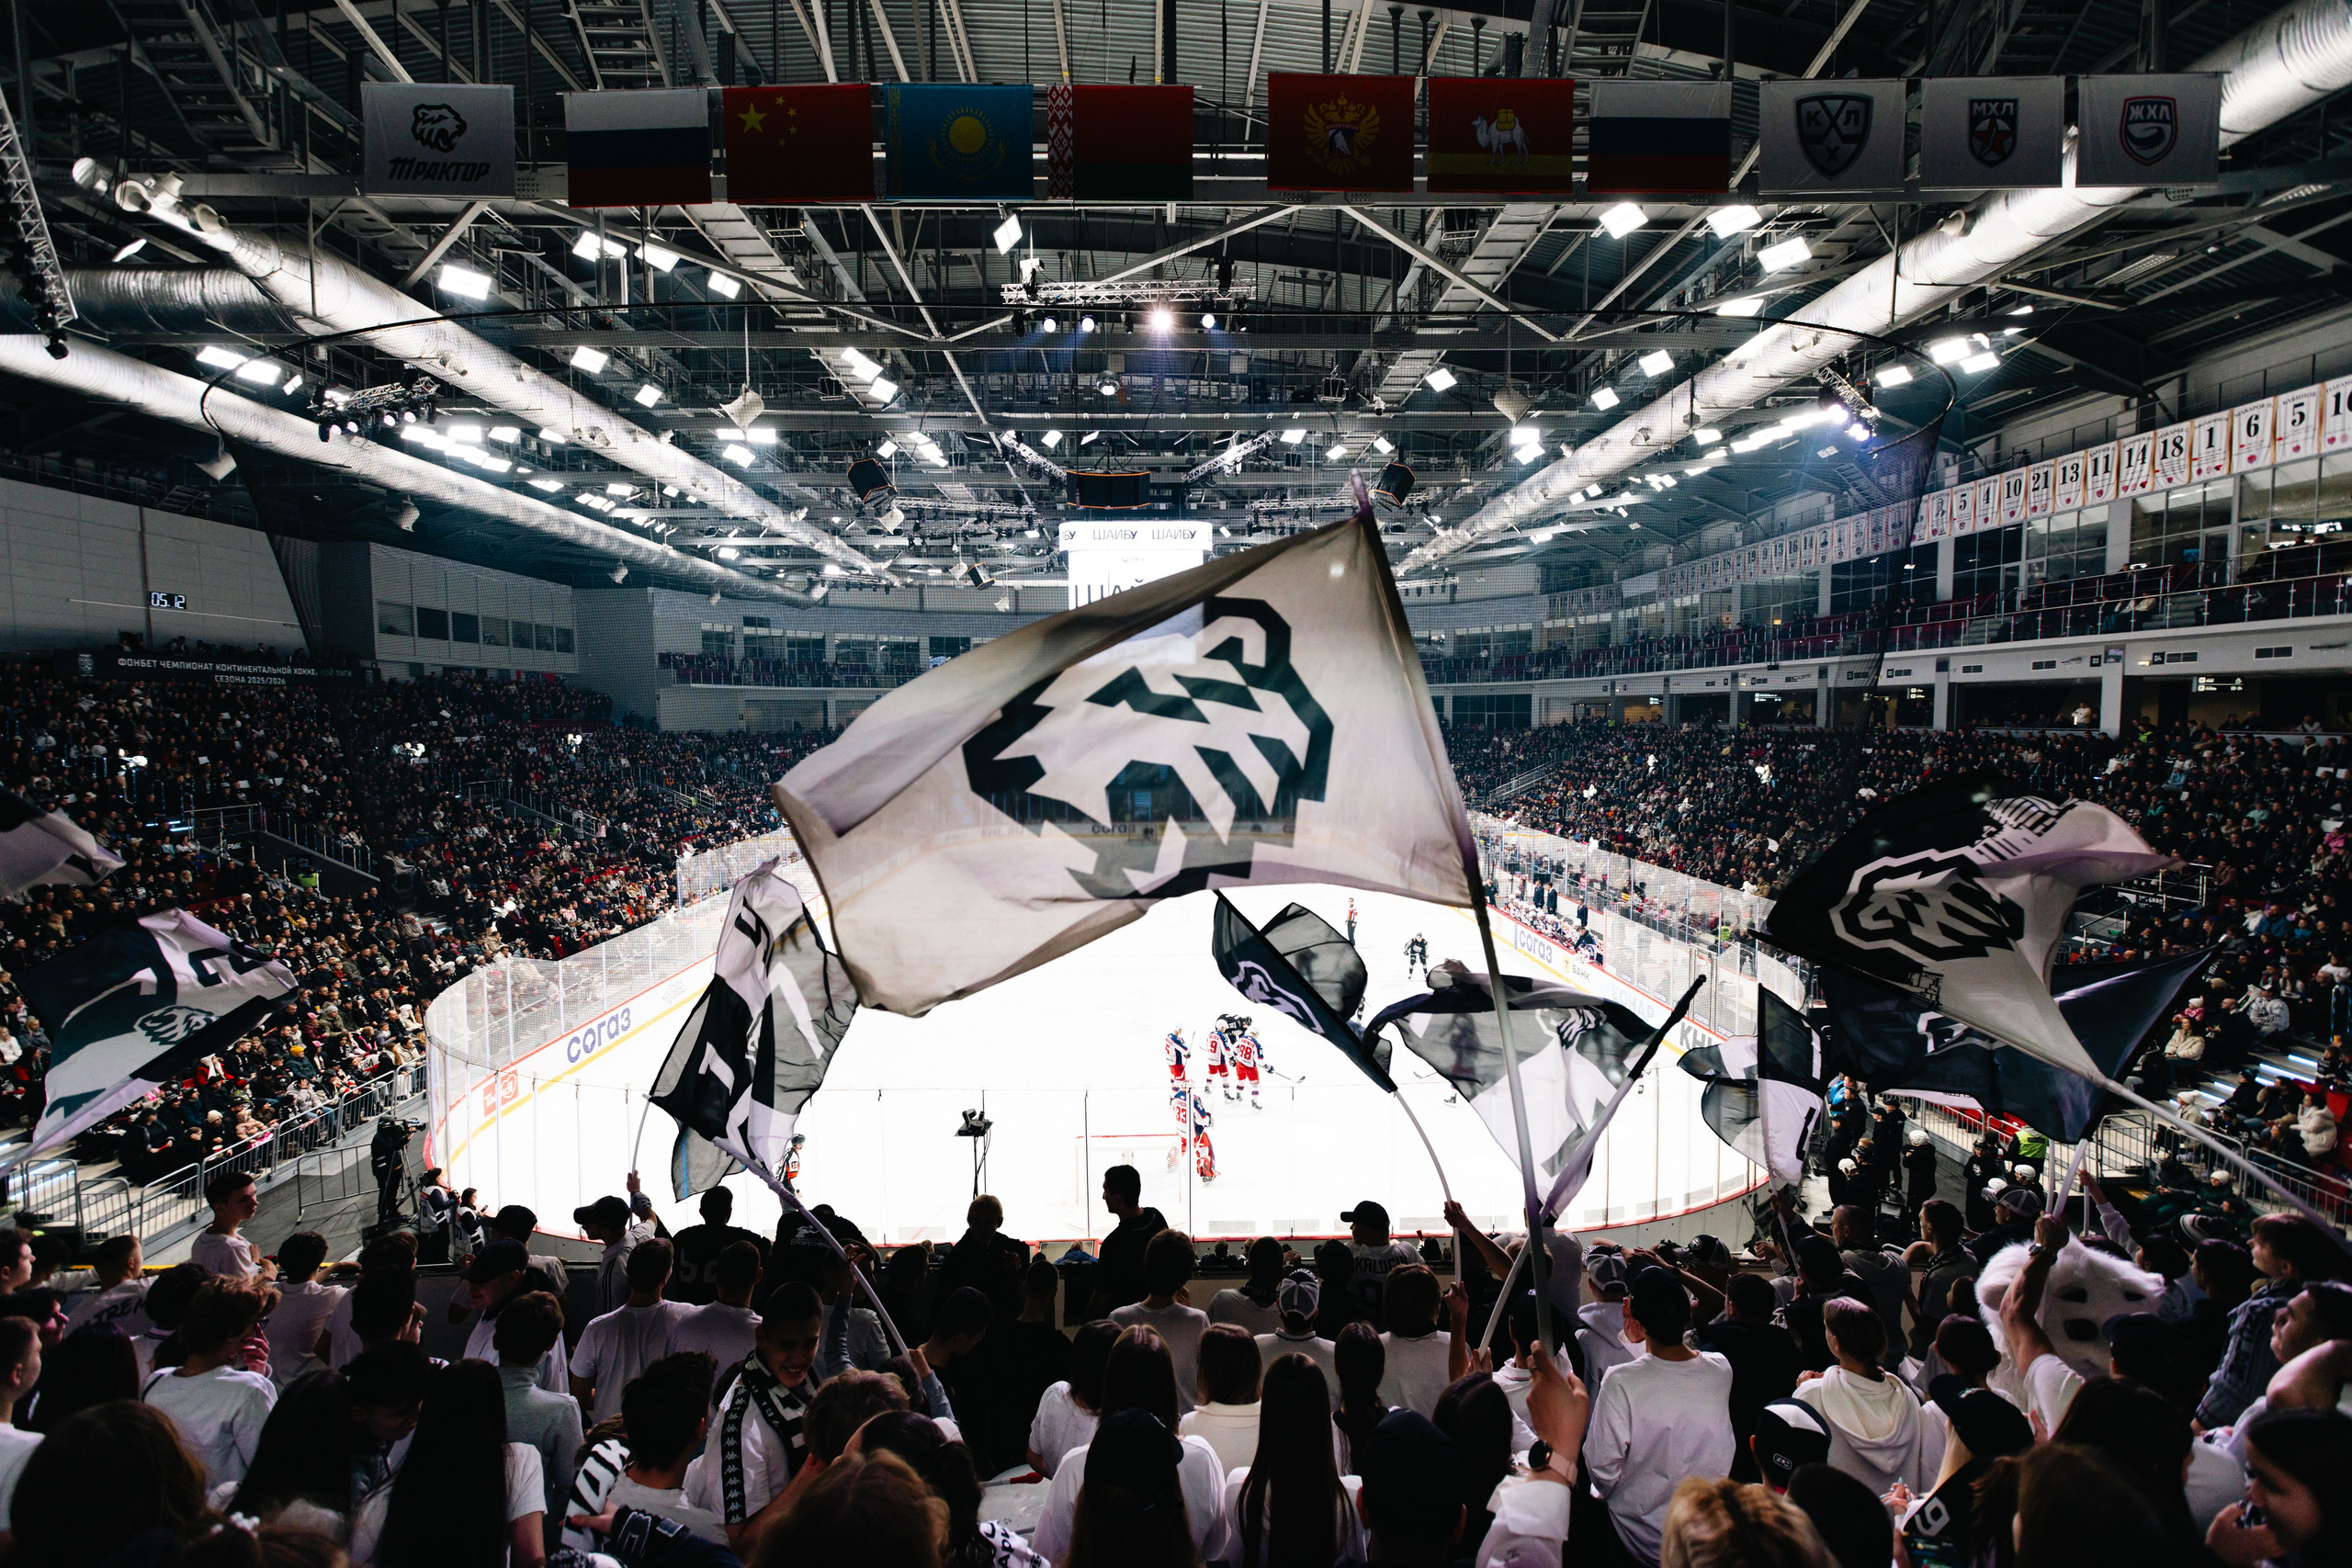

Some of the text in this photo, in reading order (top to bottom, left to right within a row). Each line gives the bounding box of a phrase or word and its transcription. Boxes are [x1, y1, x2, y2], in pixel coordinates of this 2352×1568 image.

[1972, 101, 2014, 118] МХЛ
[2128, 104, 2172, 122] ЖХЛ
[2290, 402, 2305, 426] 5
[2246, 413, 2259, 437] 6
[2161, 435, 2184, 460] 18
[2206, 427, 2215, 449] 1
[2091, 454, 2111, 477] 11
[2125, 444, 2147, 468] 14
[2031, 469, 2050, 492] 21
[2060, 463, 2080, 485] 13
[1983, 486, 1991, 504] 4
[2005, 478, 2022, 499] 10
[1959, 493, 1967, 511] 5
[1092, 527, 1137, 540] ШАЙБУ
[1151, 527, 1196, 540] ШАЙБУ
[1774, 542, 1783, 557] 13
[118, 658, 157, 669] ФОНБЕТ
[160, 660, 213, 671] ЧЕМПИОНАТ
[216, 663, 292, 676] КОНТИНЕНТАЛЬНОЙ
[214, 674, 287, 686] СЕЗОНА 2025/2026
[1572, 964, 1590, 983] БАНК
